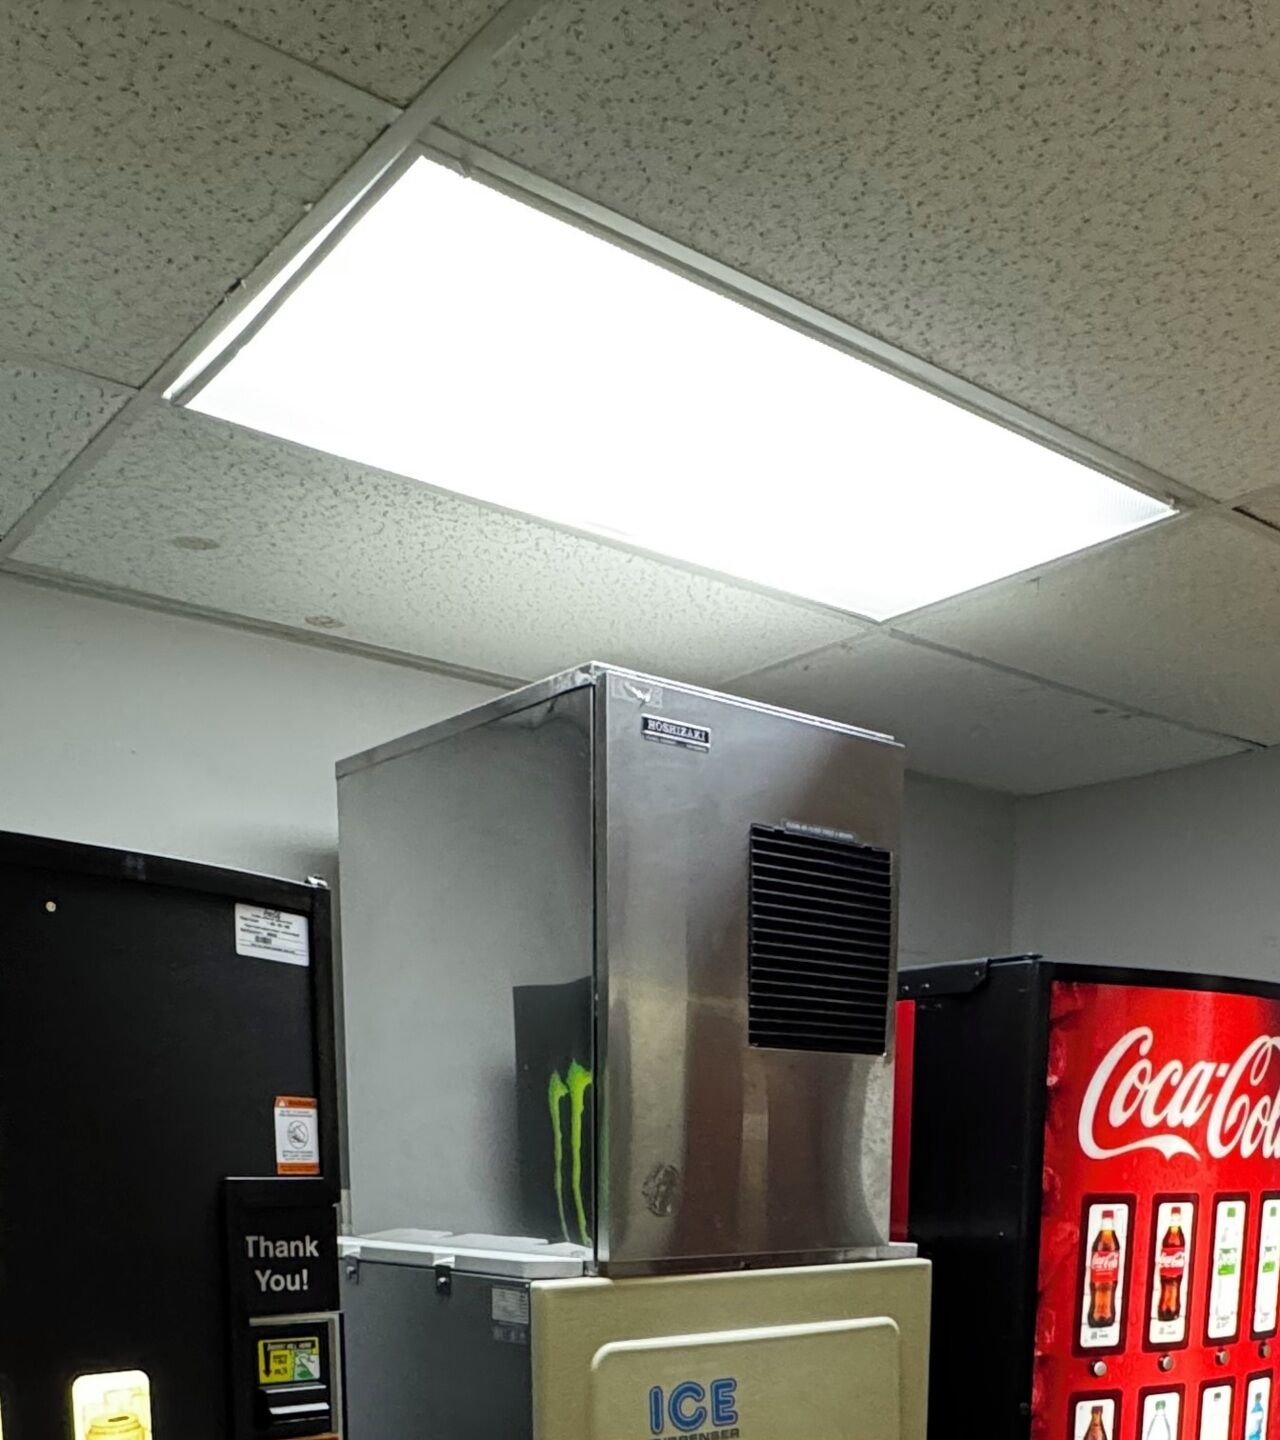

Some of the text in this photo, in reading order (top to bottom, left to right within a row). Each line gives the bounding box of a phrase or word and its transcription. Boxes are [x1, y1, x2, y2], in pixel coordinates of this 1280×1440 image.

[647, 720, 706, 741] HOSHIZAKI
[245, 1235, 320, 1258] Thank
[254, 1269, 309, 1293] You!
[649, 1378, 738, 1435] ICE
